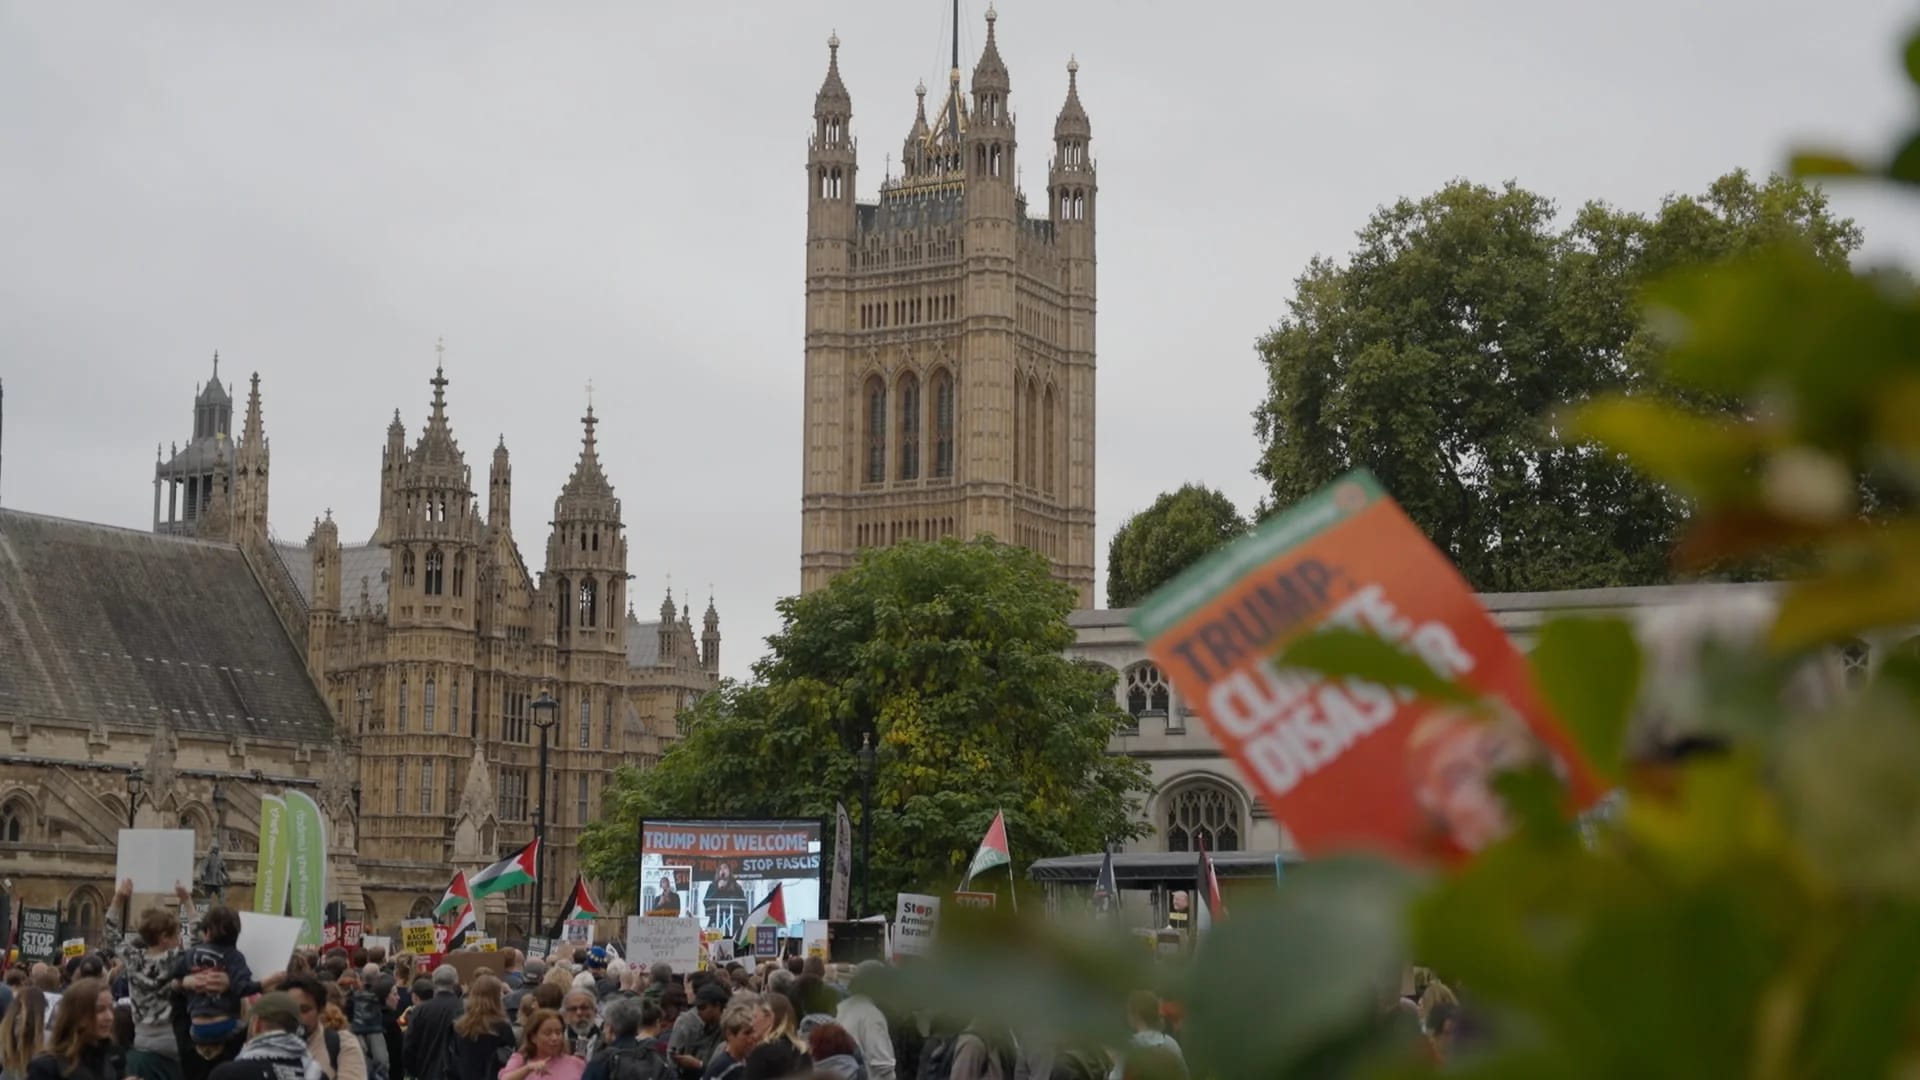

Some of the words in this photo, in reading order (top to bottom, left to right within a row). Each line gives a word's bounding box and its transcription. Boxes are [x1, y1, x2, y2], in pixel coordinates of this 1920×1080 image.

[644, 831, 697, 850] TRUMP
[700, 833, 730, 850] NOT
[733, 834, 809, 851] WELCOME
[743, 858, 773, 871] STOP
[903, 902, 933, 917] Stop
[407, 932, 431, 940] RACIST
[409, 926, 427, 934] STOP
[902, 925, 931, 937] Israel
[23, 931, 55, 946] STOP
[22, 944, 53, 956] TRUMP
